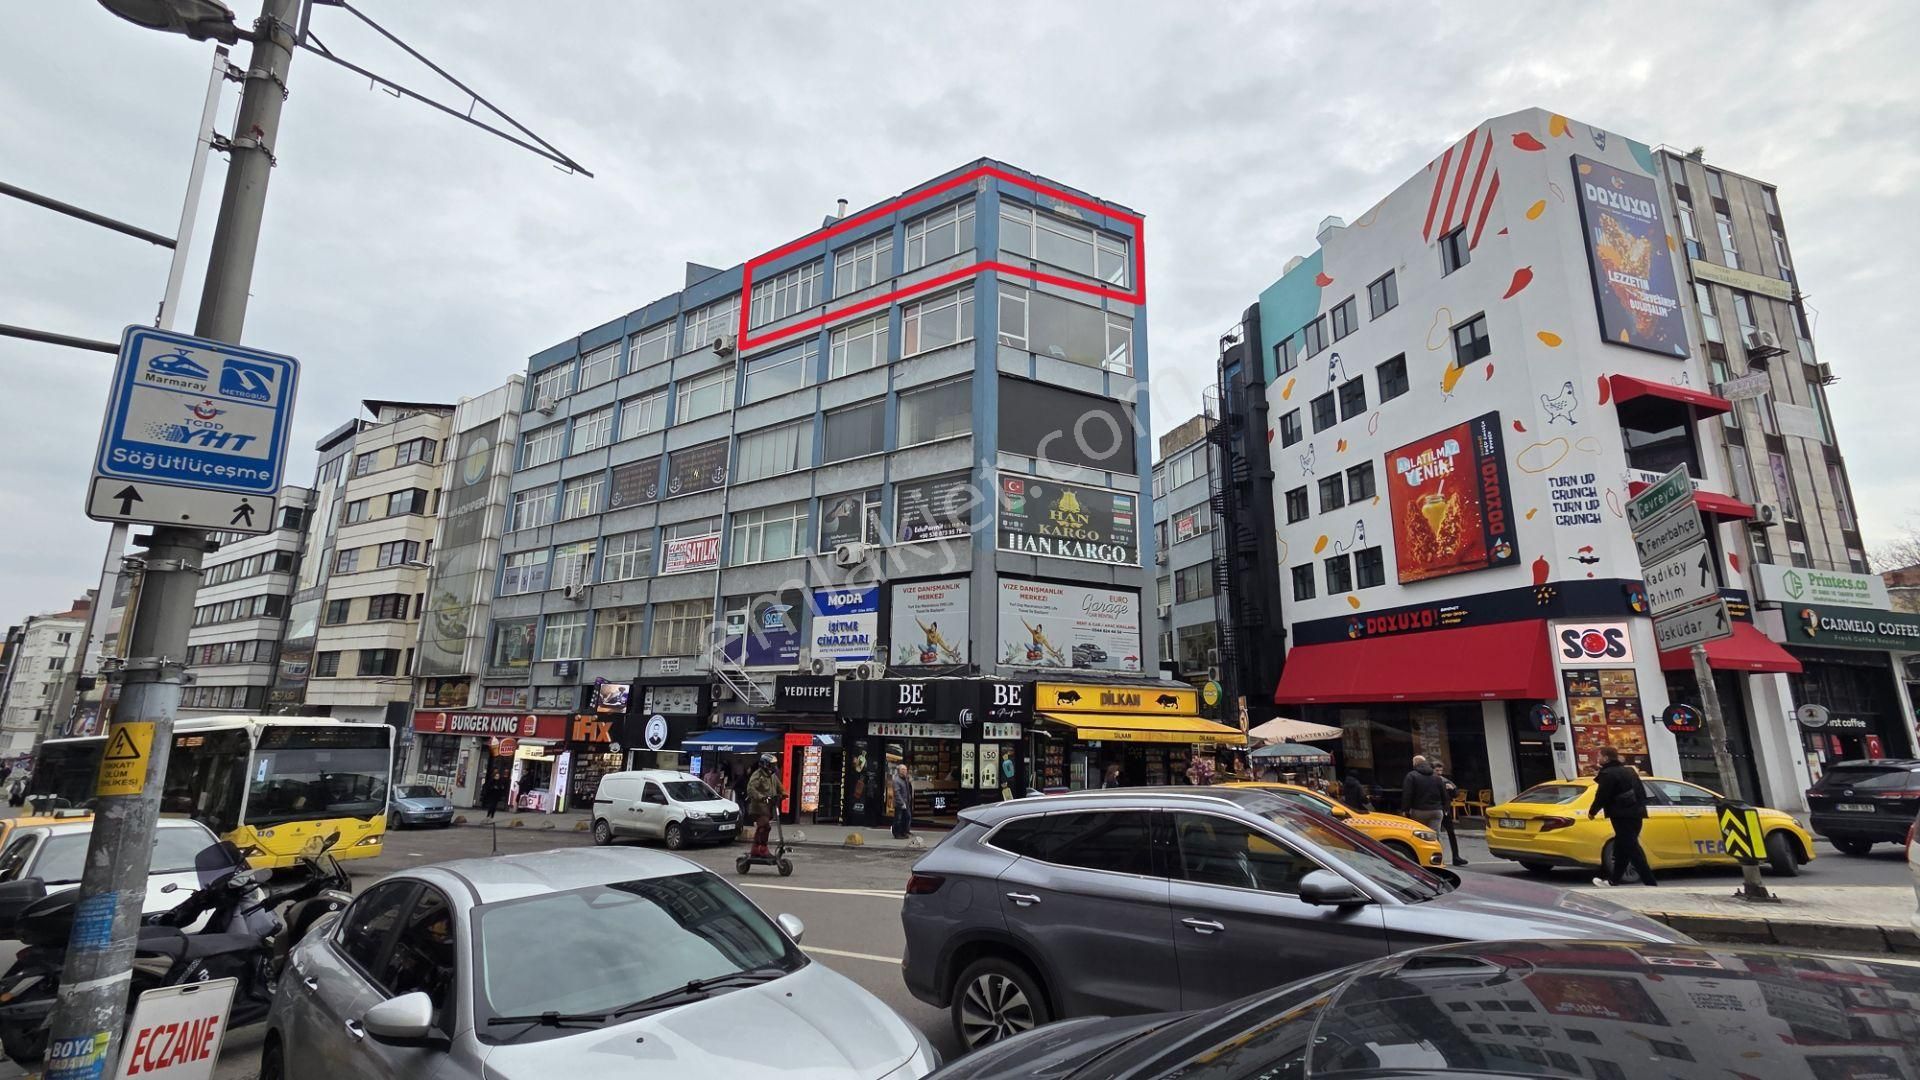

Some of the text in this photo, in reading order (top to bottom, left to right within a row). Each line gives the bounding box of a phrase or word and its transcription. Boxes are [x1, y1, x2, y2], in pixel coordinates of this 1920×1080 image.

[145, 372, 207, 391] Marmaray
[184, 418, 224, 431] TCDD
[181, 425, 256, 451] YHT
[113, 447, 270, 481] Söğütlüçeşme
[1549, 473, 1596, 488] TURN UP
[1552, 486, 1598, 500] CRUNCH
[1638, 481, 1685, 518] Çevreyolu
[1553, 499, 1600, 512] TURN UP
[1049, 510, 1089, 524] HAN
[1555, 513, 1602, 526] CRUNCH
[1038, 524, 1099, 541] KARGO
[1646, 519, 1695, 551] Fenerbahçe
[685, 539, 719, 563] SATILIK
[1009, 533, 1126, 563] HAN KARGO
[1645, 562, 1687, 586] Kadıköy
[1808, 572, 1868, 590] Printecs.co
[828, 592, 863, 606] MODA
[1109, 595, 1128, 604] EURO
[1650, 586, 1684, 607] Rıhtım
[1082, 593, 1128, 620] Garage
[828, 620, 859, 634] İŞİTME
[1366, 610, 1438, 634] DOYUYO!
[1656, 620, 1703, 642] Üsküdar
[1820, 616, 1920, 637] CARMELO COFFEE
[817, 634, 869, 646] CİHAZLARI
[1560, 627, 1627, 659] SOS
[784, 685, 831, 697] YEDITEPE
[899, 684, 923, 704] BE
[994, 684, 1022, 706] BE
[1100, 690, 1140, 707] DİLKAN
[451, 715, 518, 733] BURGER KING
[573, 714, 612, 743] iFix
[724, 715, 745, 726] AKEL
[1842, 718, 1866, 728] coffee
[52, 1038, 94, 1057] BOYA
[127, 1015, 219, 1076] ECZANE
